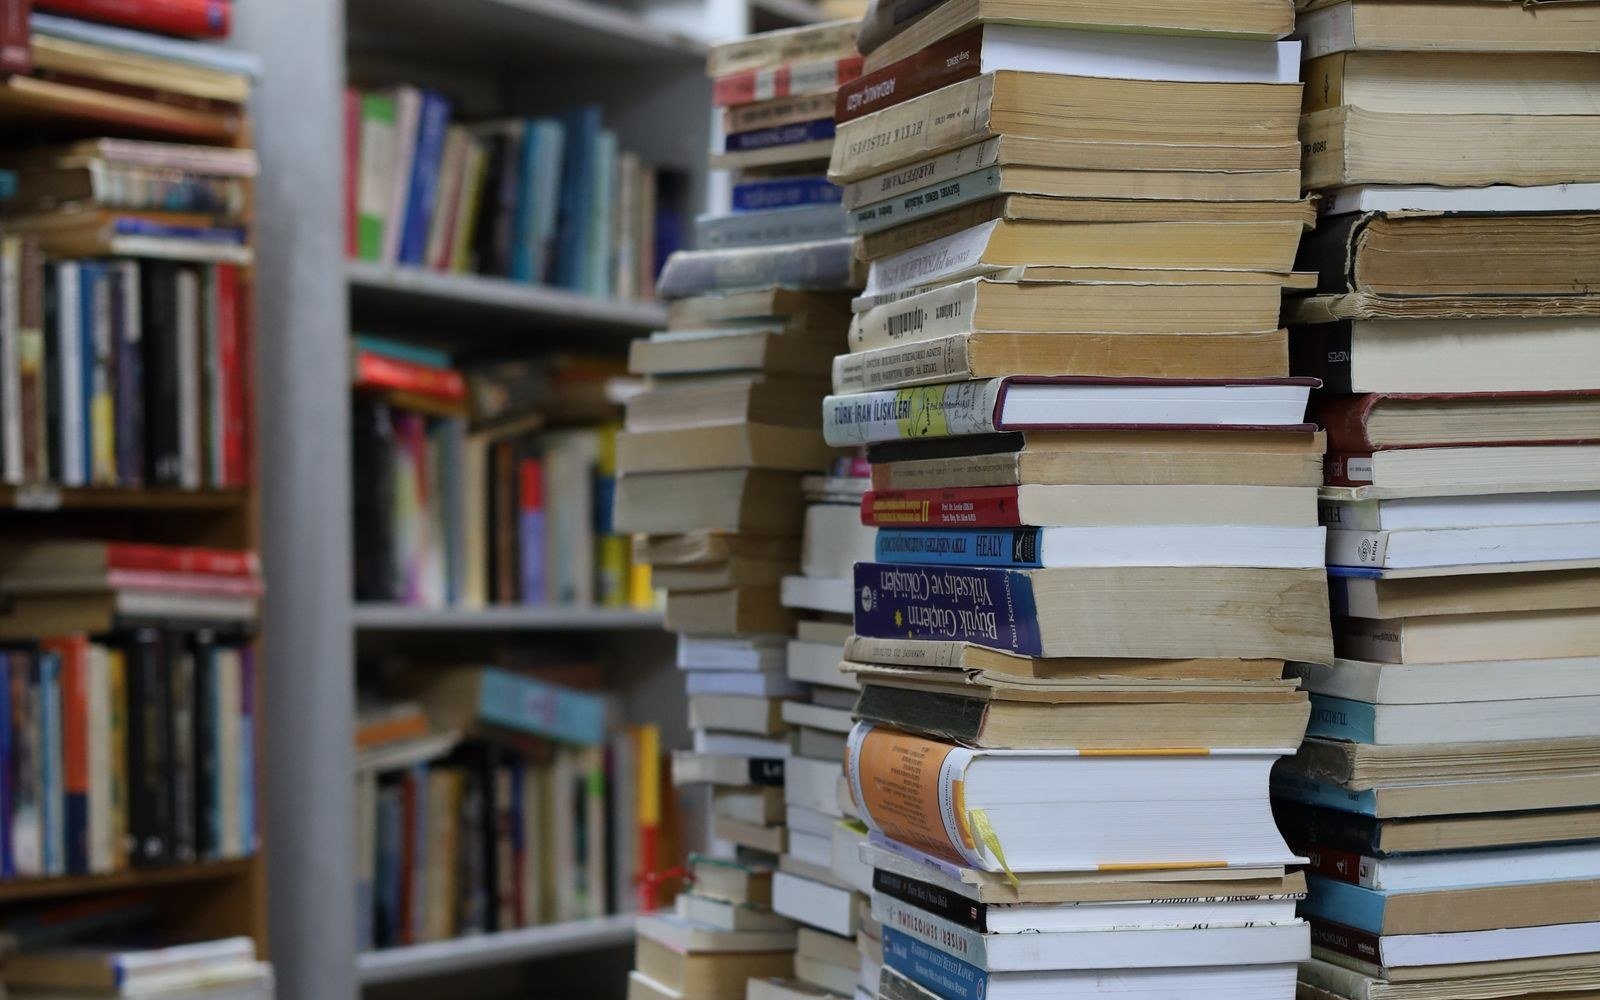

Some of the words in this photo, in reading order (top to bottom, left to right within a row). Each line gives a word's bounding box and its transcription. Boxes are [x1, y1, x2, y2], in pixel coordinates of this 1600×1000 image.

[976, 536, 1004, 557] HEALY
[881, 570, 930, 600] Çöküşleri
[932, 576, 944, 594] ve
[945, 570, 993, 606] Yükseliş
[1004, 573, 1016, 622] Kennedy
[908, 605, 957, 638] Güçlerin
[960, 605, 998, 640] Büyük
[1010, 623, 1019, 649] Paul
